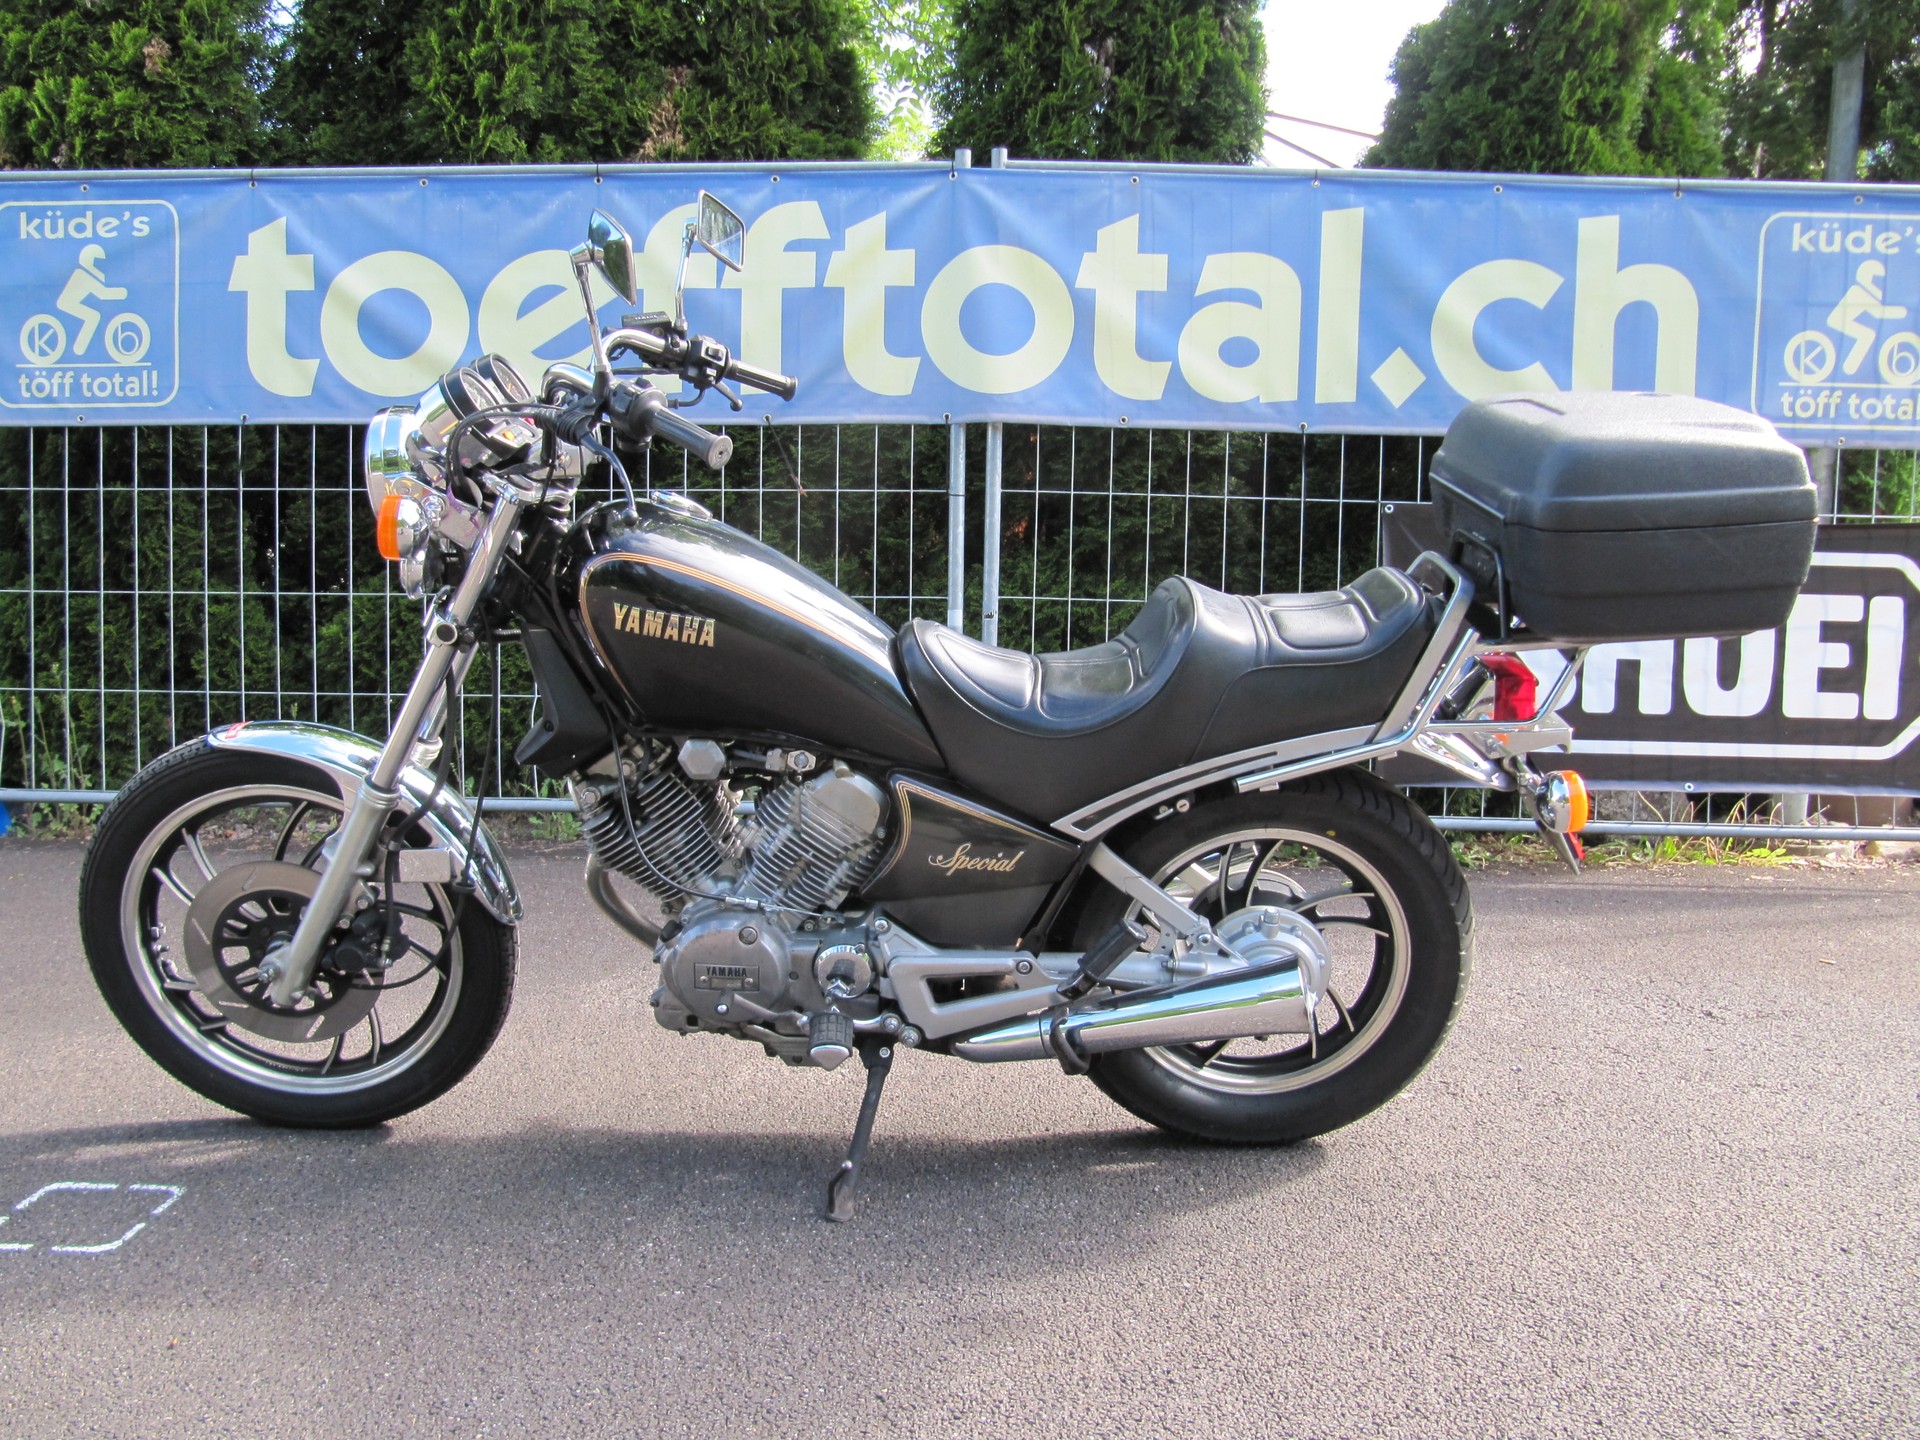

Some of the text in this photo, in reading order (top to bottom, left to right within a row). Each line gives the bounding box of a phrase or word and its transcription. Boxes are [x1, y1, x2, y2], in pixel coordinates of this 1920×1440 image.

[19, 210, 151, 240] küde's
[1791, 222, 1920, 254] küde'
[228, 200, 1700, 409] toefftotal.ch
[19, 369, 159, 398] töff total!
[1781, 388, 1843, 418] töff
[613, 602, 716, 647] YAMAHA
[1516, 593, 1905, 721] HOEI
[928, 842, 1026, 876] Special
[705, 966, 748, 977] YAMAHA
